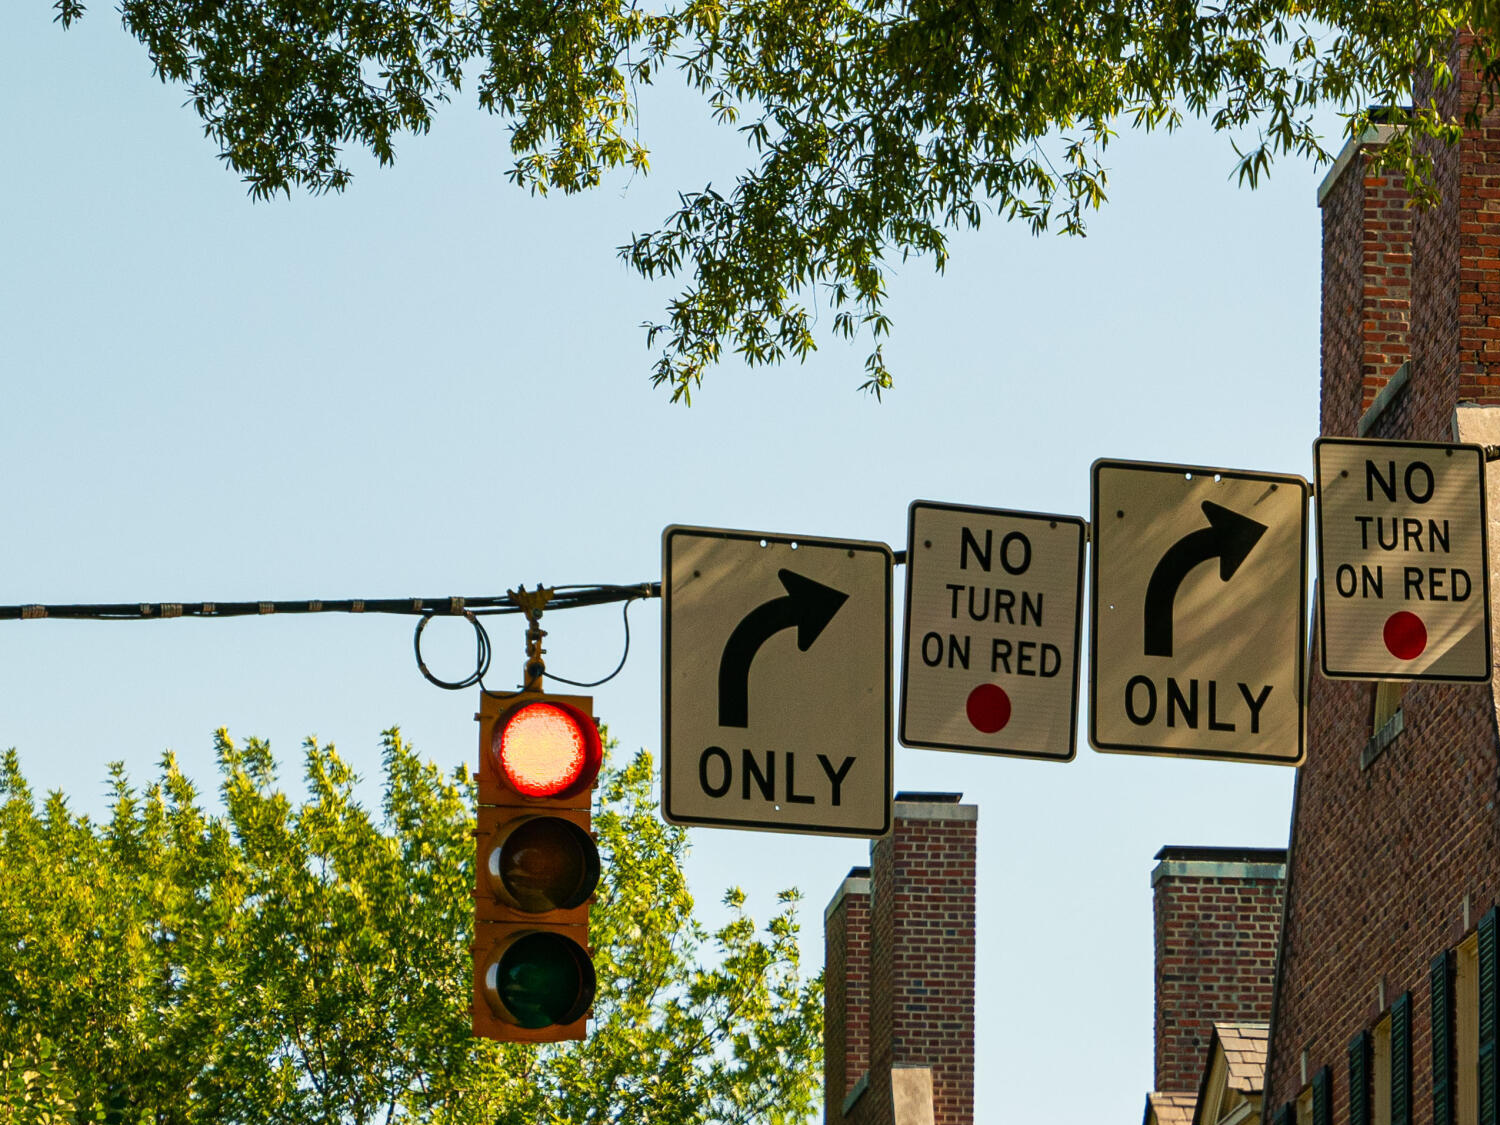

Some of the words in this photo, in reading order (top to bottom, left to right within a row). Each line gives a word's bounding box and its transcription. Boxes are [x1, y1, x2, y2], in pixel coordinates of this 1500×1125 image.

[1365, 459, 1436, 505] NO
[959, 526, 1032, 576] NO
[1354, 515, 1451, 554] TURN
[945, 583, 1044, 628] TURN
[1335, 563, 1384, 600] ON
[1403, 566, 1472, 603] RED
[921, 631, 971, 670] ON
[990, 638, 1062, 679] RED
[1124, 674, 1274, 734] ONLY
[698, 745, 857, 807] ONLY
